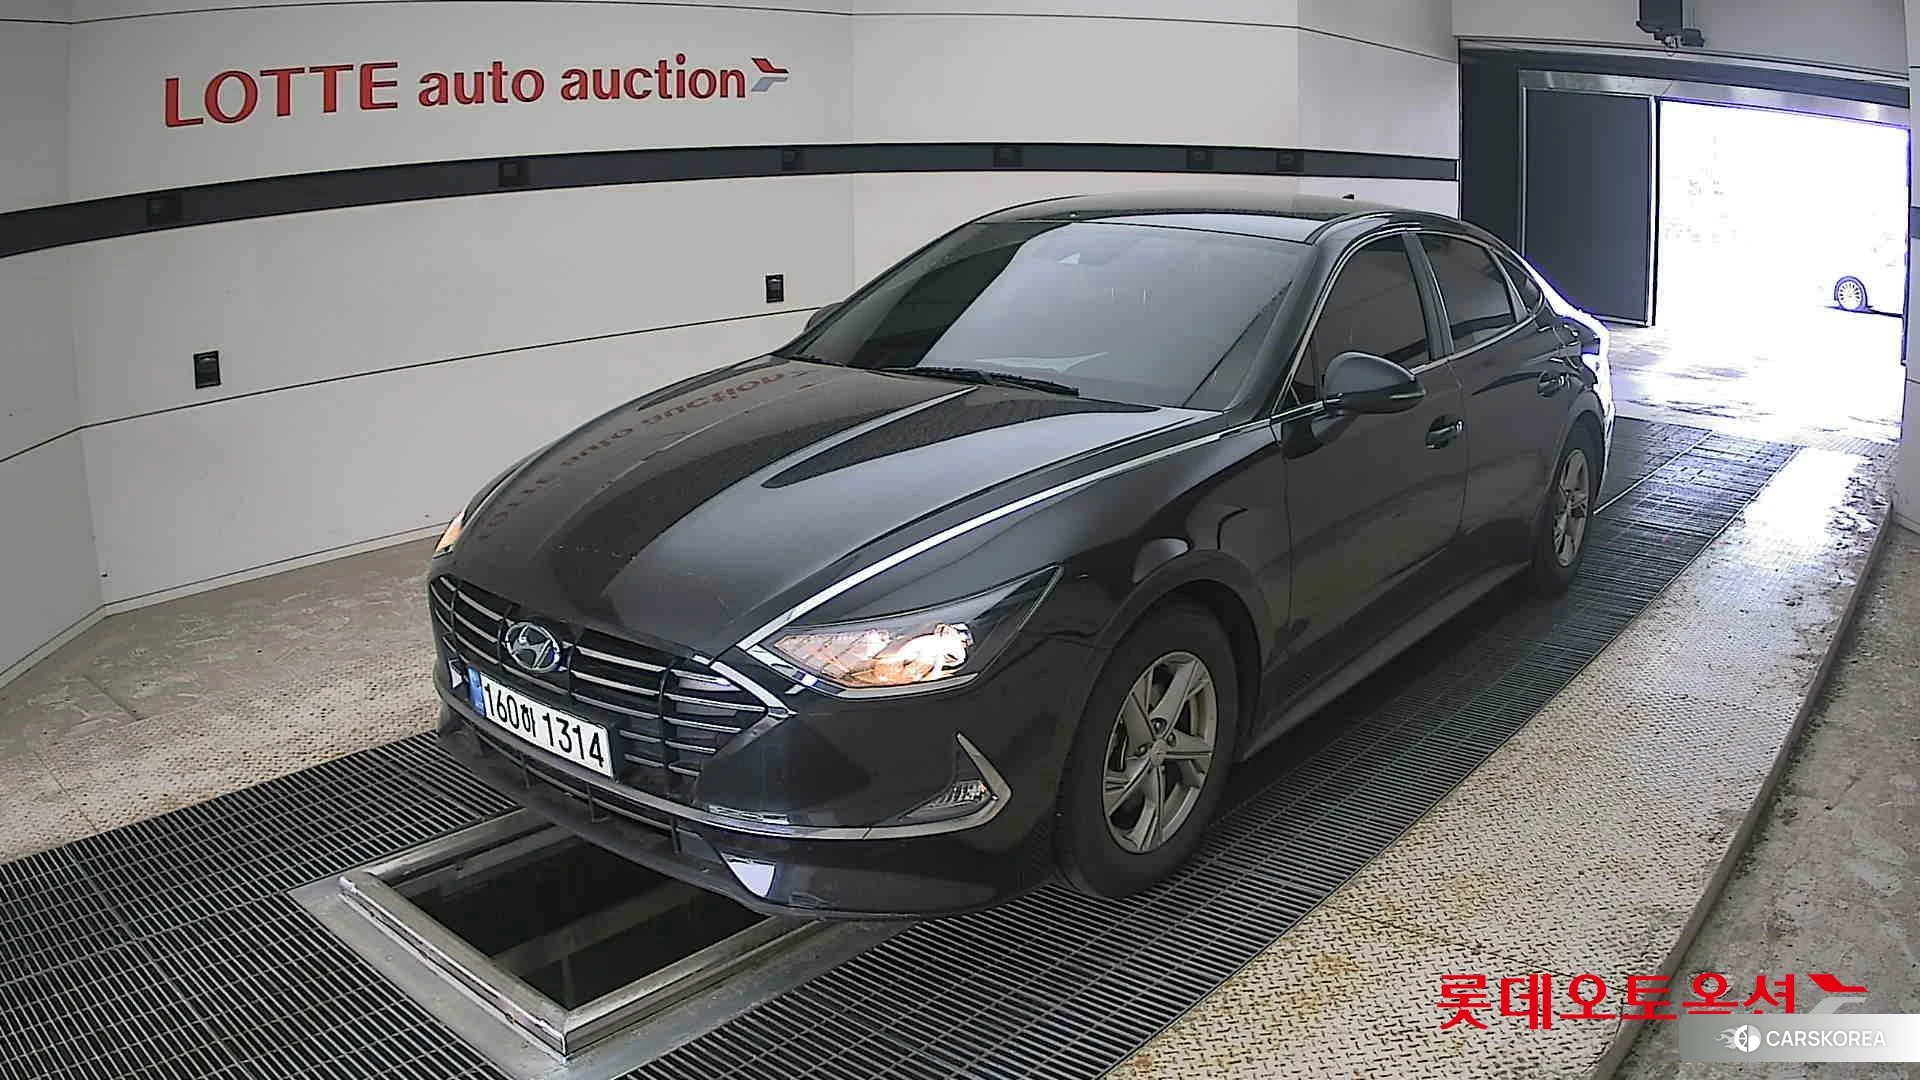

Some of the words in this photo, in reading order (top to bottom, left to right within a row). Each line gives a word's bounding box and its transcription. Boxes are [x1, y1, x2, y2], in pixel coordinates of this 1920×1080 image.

[164, 61, 399, 128] LOTTE
[418, 60, 546, 107] auto
[560, 52, 747, 100] auction
[542, 712, 605, 768] 1314
